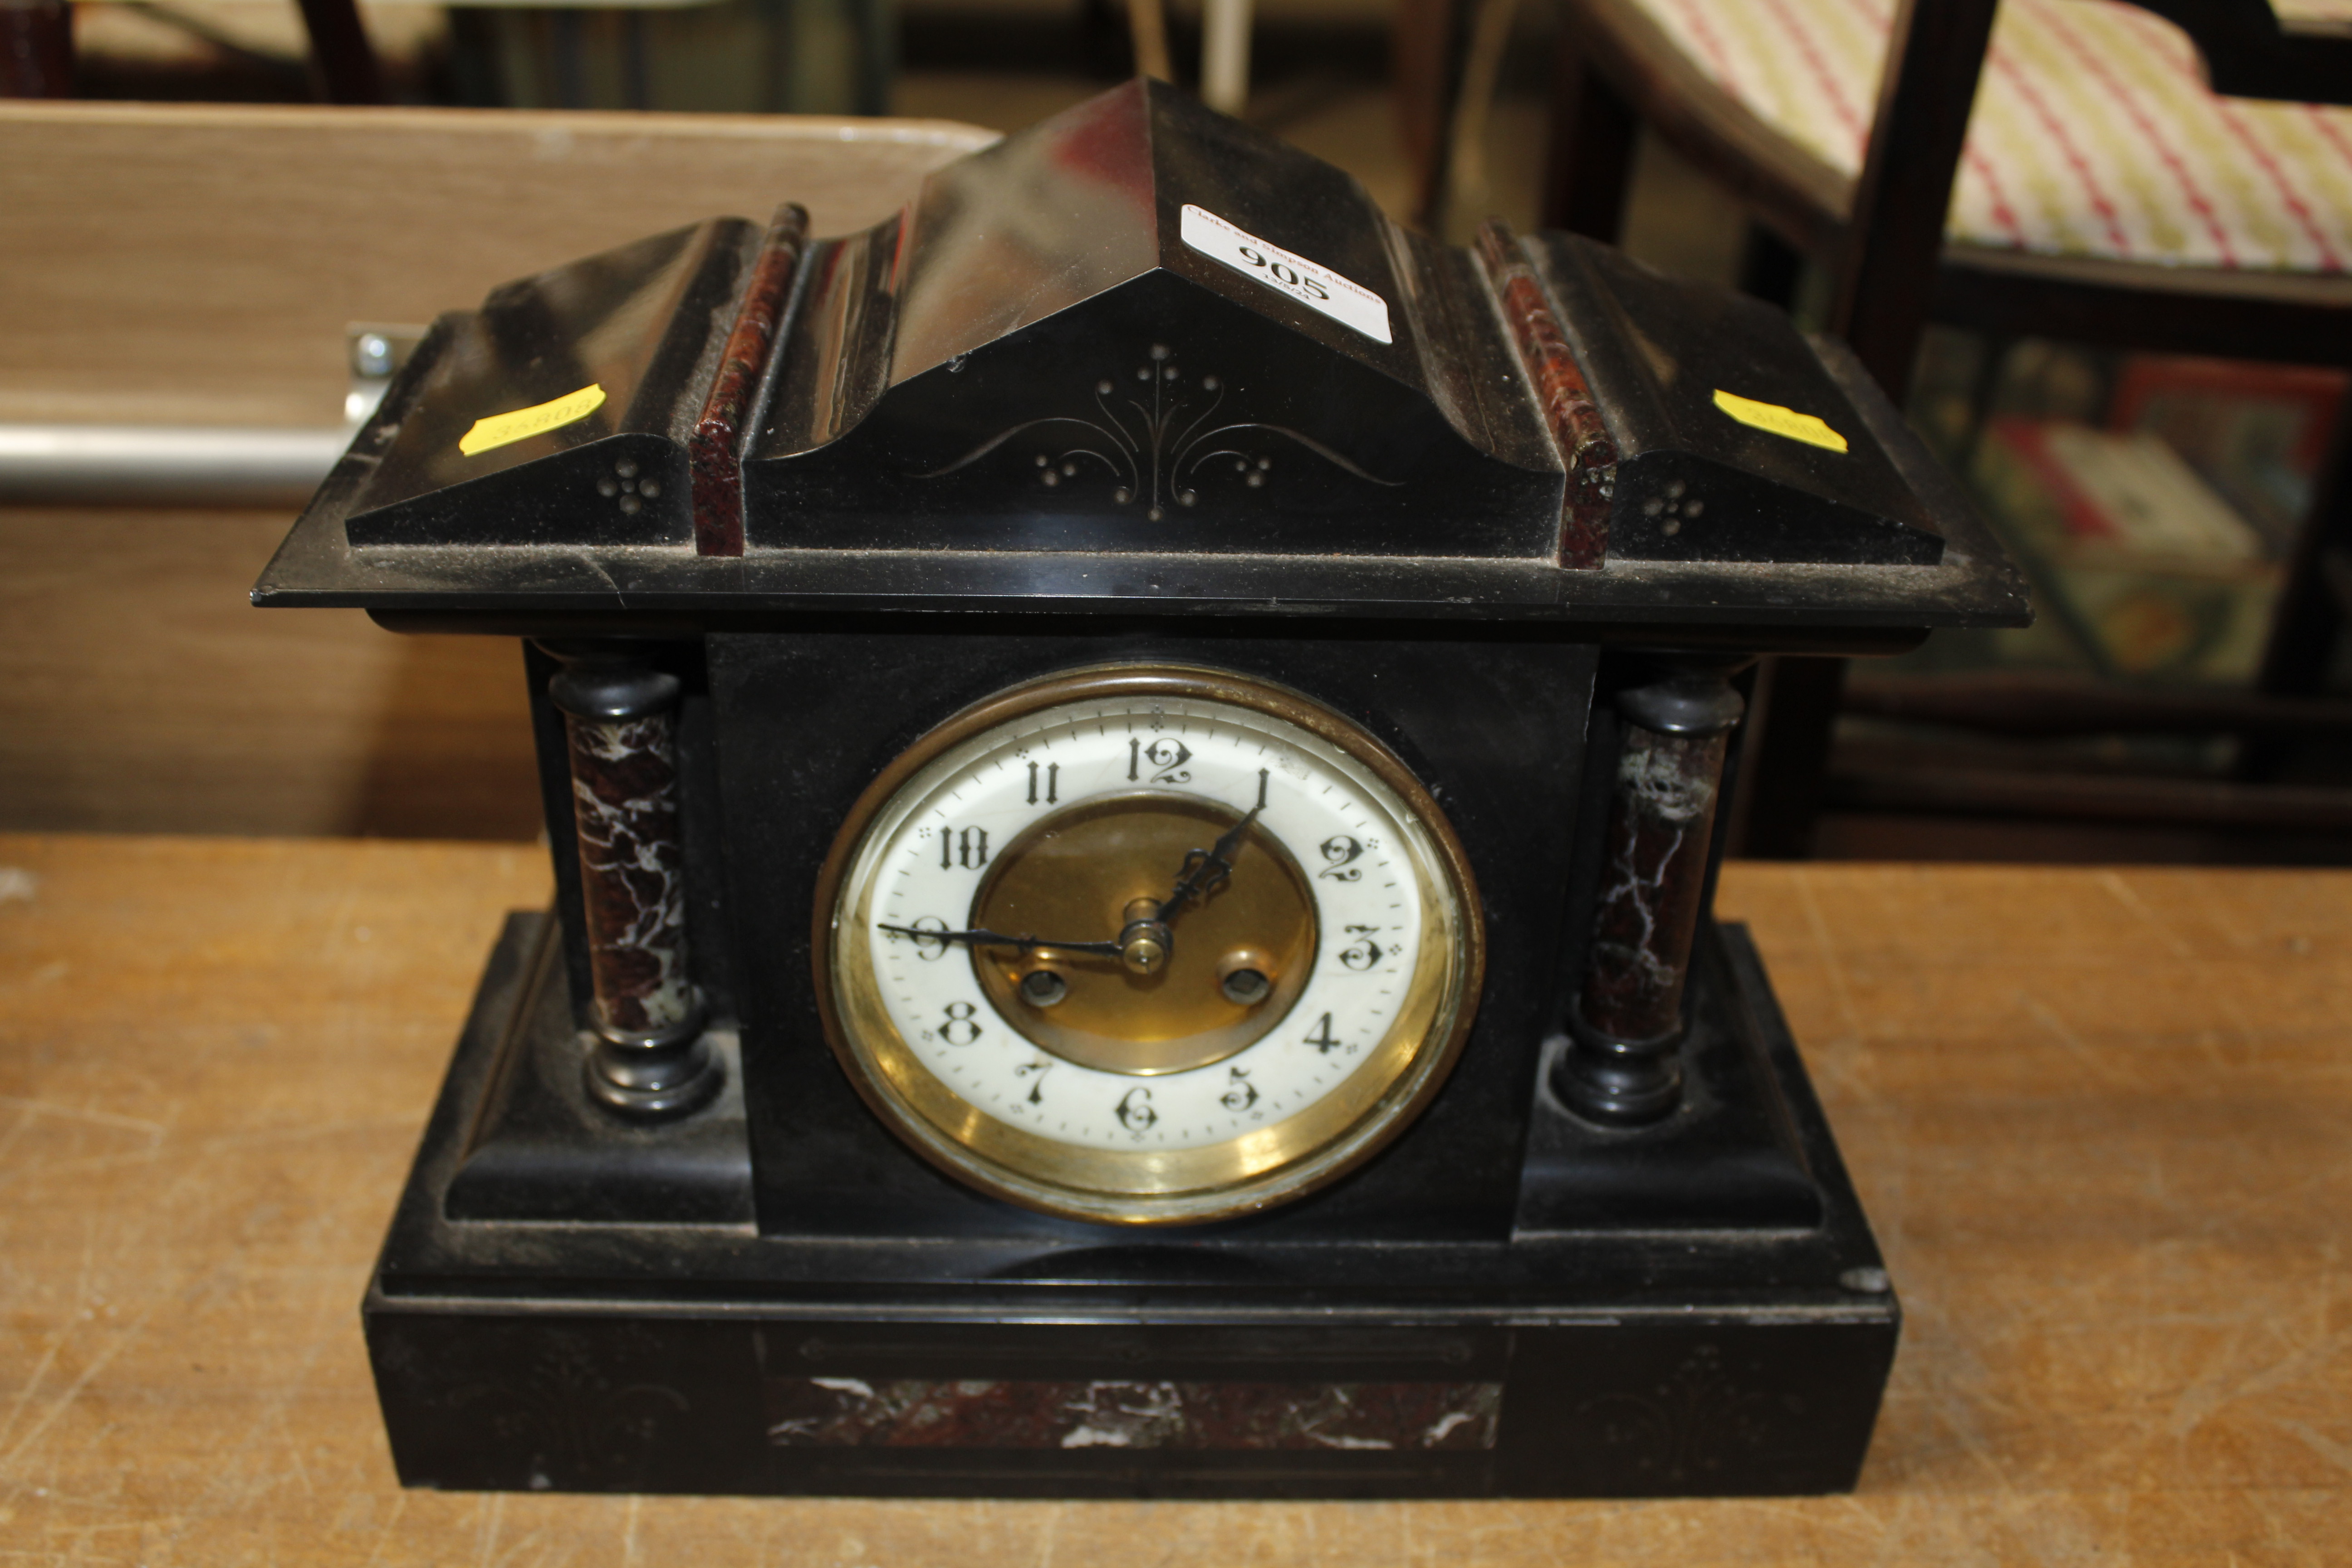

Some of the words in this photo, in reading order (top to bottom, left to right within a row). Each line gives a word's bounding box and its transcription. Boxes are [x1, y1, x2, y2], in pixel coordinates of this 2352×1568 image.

[1187, 206, 1230, 231] Clarke
[1234, 230, 1258, 245] and
[1262, 243, 1318, 274] Simpson
[1324, 273, 1382, 304] Auctions
[1239, 246, 1330, 300] 905
[1026, 760, 1061, 805] 11
[1127, 736, 1193, 785] 12
[1256, 767, 1270, 810] 1
[939, 824, 991, 871] 10
[1319, 835, 1364, 882] 2
[908, 916, 952, 961] 9
[1338, 924, 1383, 970] 3
[938, 1002, 984, 1047] 8
[1303, 1011, 1342, 1055] 4
[1014, 1062, 1052, 1106] 7
[1220, 1066, 1259, 1112] 5
[1114, 1086, 1158, 1131] 6
